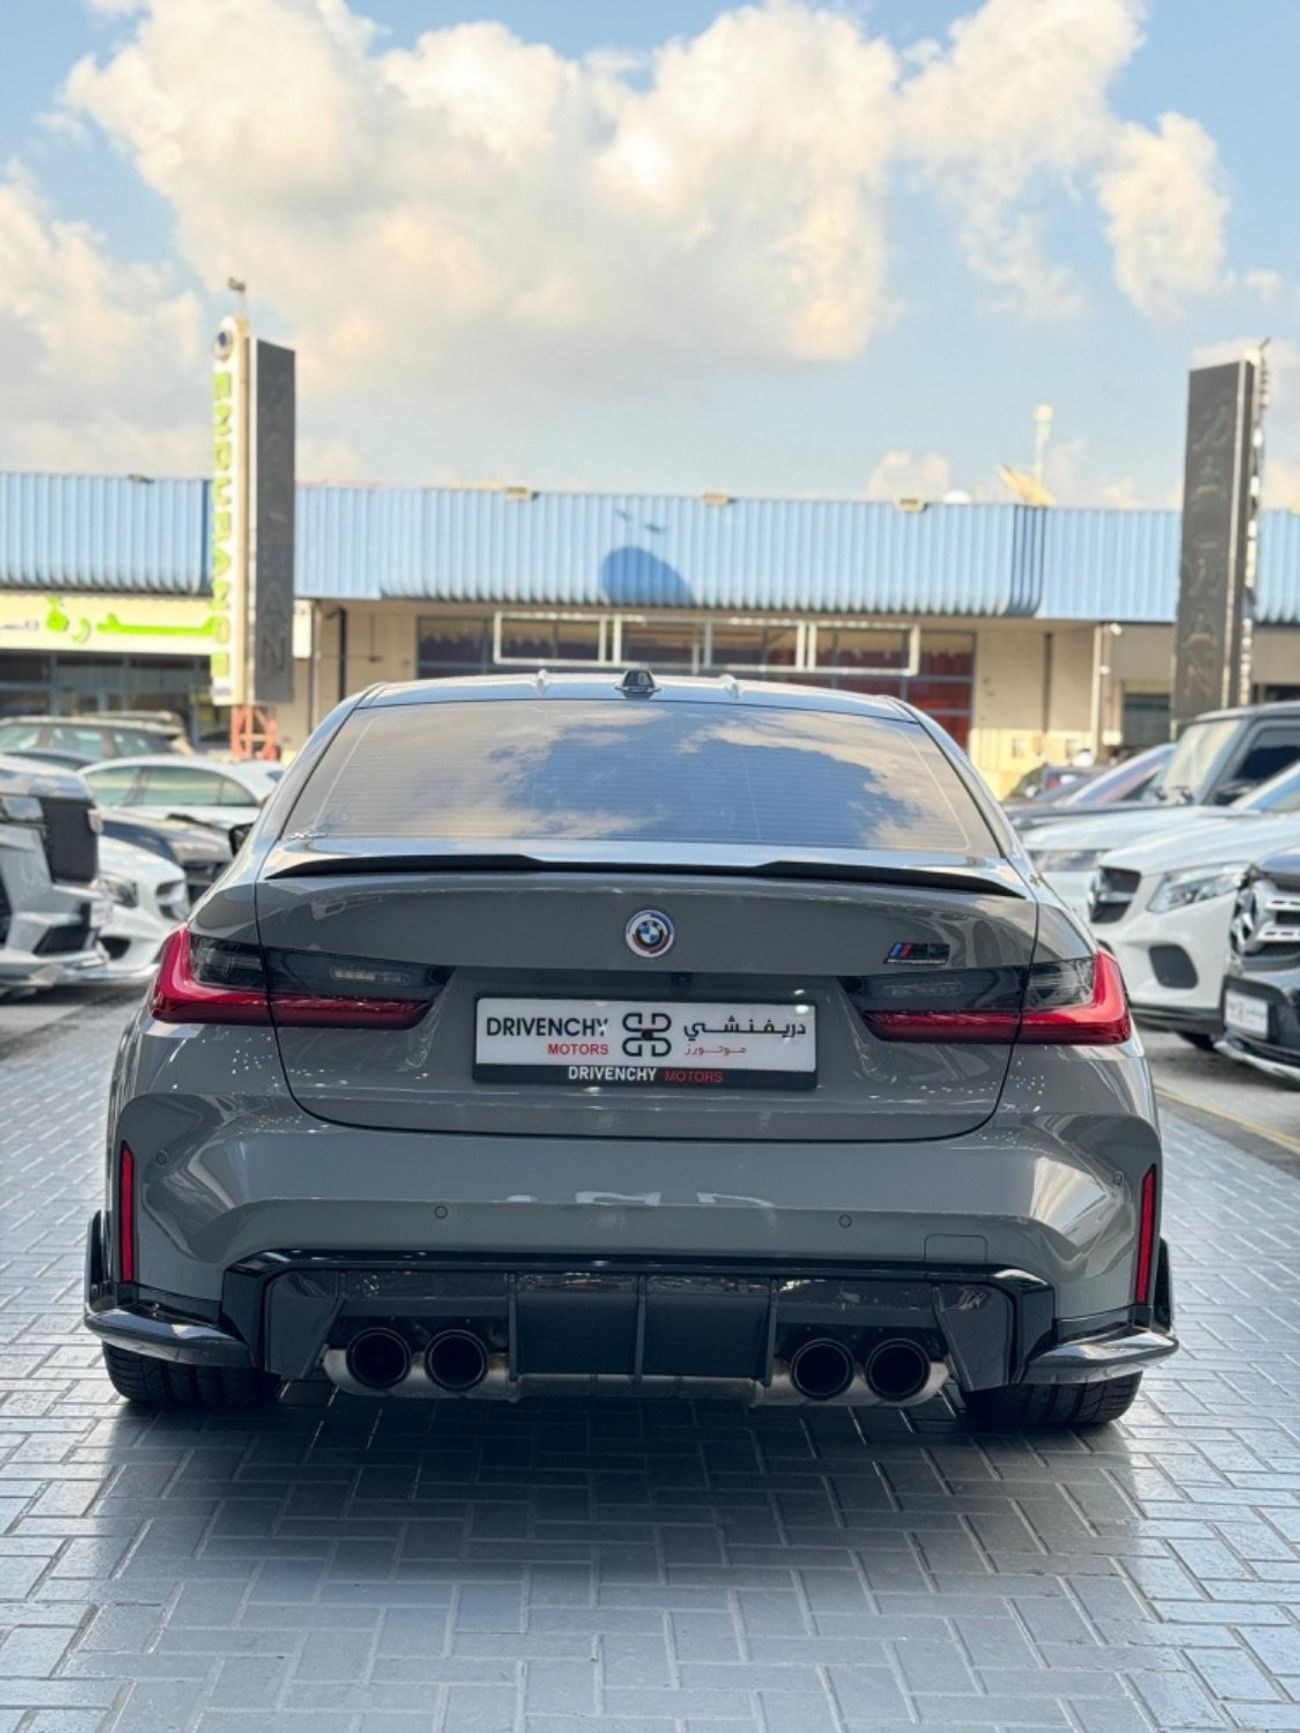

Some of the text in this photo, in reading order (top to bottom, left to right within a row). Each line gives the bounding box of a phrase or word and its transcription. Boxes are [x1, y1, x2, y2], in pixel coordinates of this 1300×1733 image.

[486, 1017, 608, 1037] DRIVENCHY
[547, 1043, 609, 1056] MOTORS
[568, 1066, 724, 1084] DRIVENCHY MOTORS
